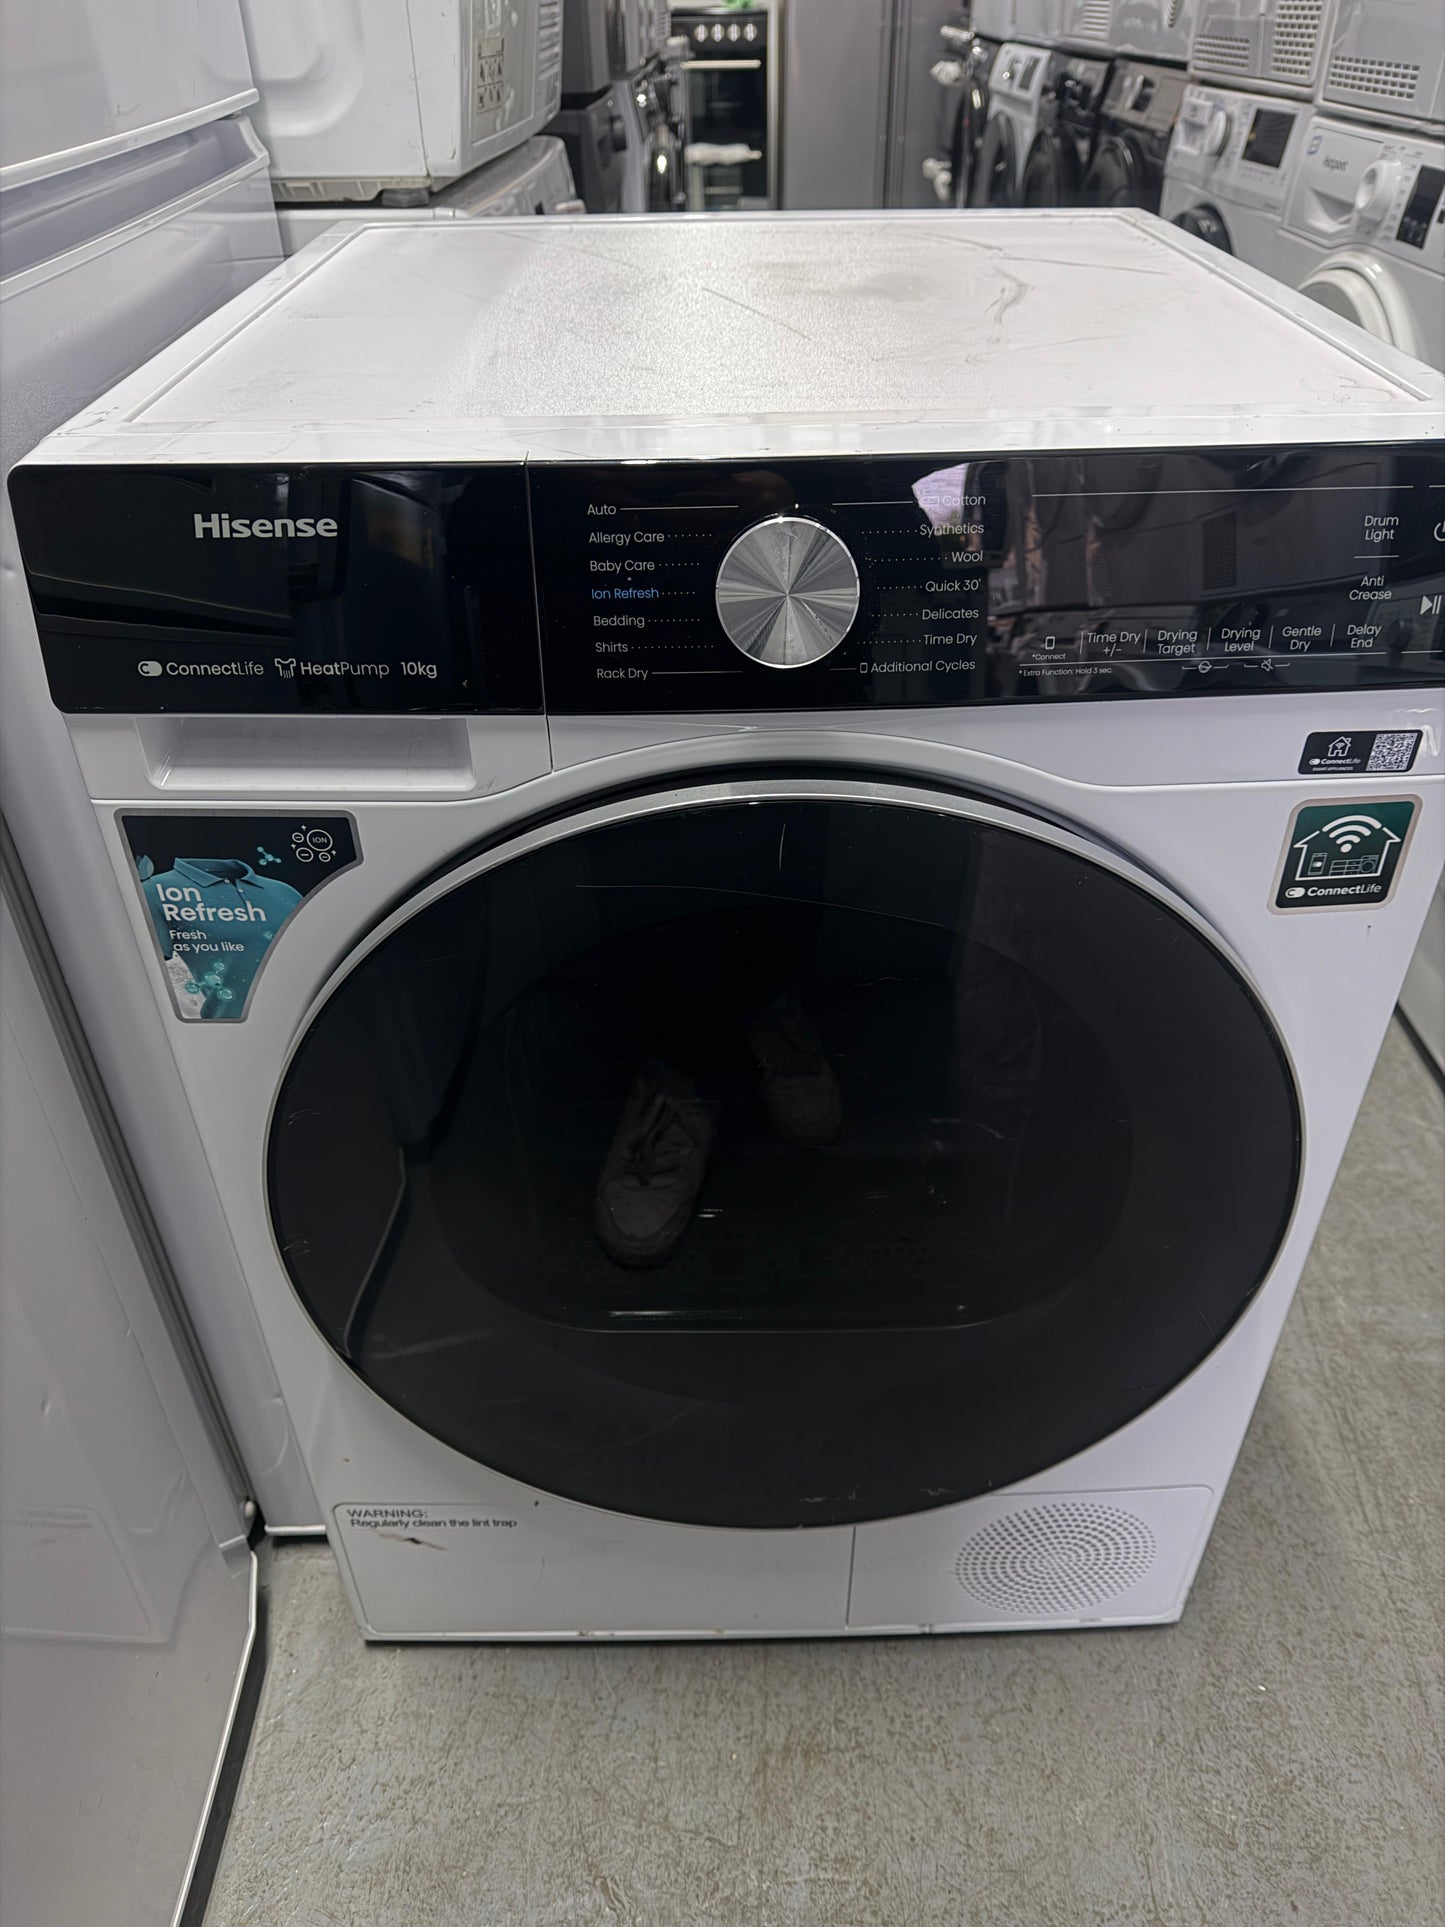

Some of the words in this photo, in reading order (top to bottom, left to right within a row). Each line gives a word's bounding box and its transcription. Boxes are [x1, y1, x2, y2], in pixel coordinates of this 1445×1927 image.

[942, 495, 986, 507] Cotton
[587, 503, 617, 516] Auto
[194, 513, 338, 538] Hisense
[1364, 515, 1399, 528] Drum
[920, 523, 984, 538] Synthetics
[1365, 528, 1395, 543] Light
[588, 531, 633, 547] Allergy
[635, 531, 665, 544] Care
[951, 550, 983, 563] Wool
[590, 559, 622, 574] Baby
[624, 559, 656, 572] Care
[925, 580, 960, 594] Quick
[1360, 575, 1385, 588] Anti
[591, 588, 612, 600] Ion
[613, 586, 659, 599] Refresh
[1349, 588, 1392, 601] Crease
[593, 614, 645, 629] Bedding
[922, 608, 979, 621] Delicates
[1157, 629, 1198, 644] Drying
[1221, 627, 1261, 642] Drying
[1282, 625, 1322, 638] Gentle
[1347, 624, 1382, 638] Delay
[923, 634, 953, 646] Time
[954, 633, 978, 647] Dry
[1087, 632, 1117, 643] Time
[1119, 631, 1141, 646] Dry
[1290, 638, 1311, 653] Dry
[1350, 637, 1374, 649] End
[595, 641, 629, 653] Shirts
[1157, 642, 1196, 657] Target
[1224, 640, 1255, 653] Level
[166, 660, 264, 678] ConnectLife
[300, 660, 390, 680] HeatPump
[401, 661, 438, 680] 10kg
[871, 660, 933, 674] Additional
[935, 660, 976, 674] Cycles
[1023, 669, 1040, 677] Extra
[1041, 668, 1074, 676] Function:
[1075, 667, 1092, 675] Hold
[597, 667, 625, 679] Rack
[626, 667, 648, 682] Dry
[312, 836, 328, 844] ION
[156, 883, 202, 902] Ion
[1307, 883, 1382, 898] ConnectLife
[162, 901, 267, 922] Refresh
[169, 930, 207, 941] Fresh
[173, 943, 190, 952] as
[192, 942, 219, 954] you
[221, 941, 244, 952] like
[347, 1509, 428, 1518] WARNING:
[350, 1519, 409, 1529] Regularly
[412, 1519, 446, 1528] clean
[449, 1519, 469, 1528] the
[472, 1519, 490, 1528] lint
[492, 1519, 517, 1529] trap
